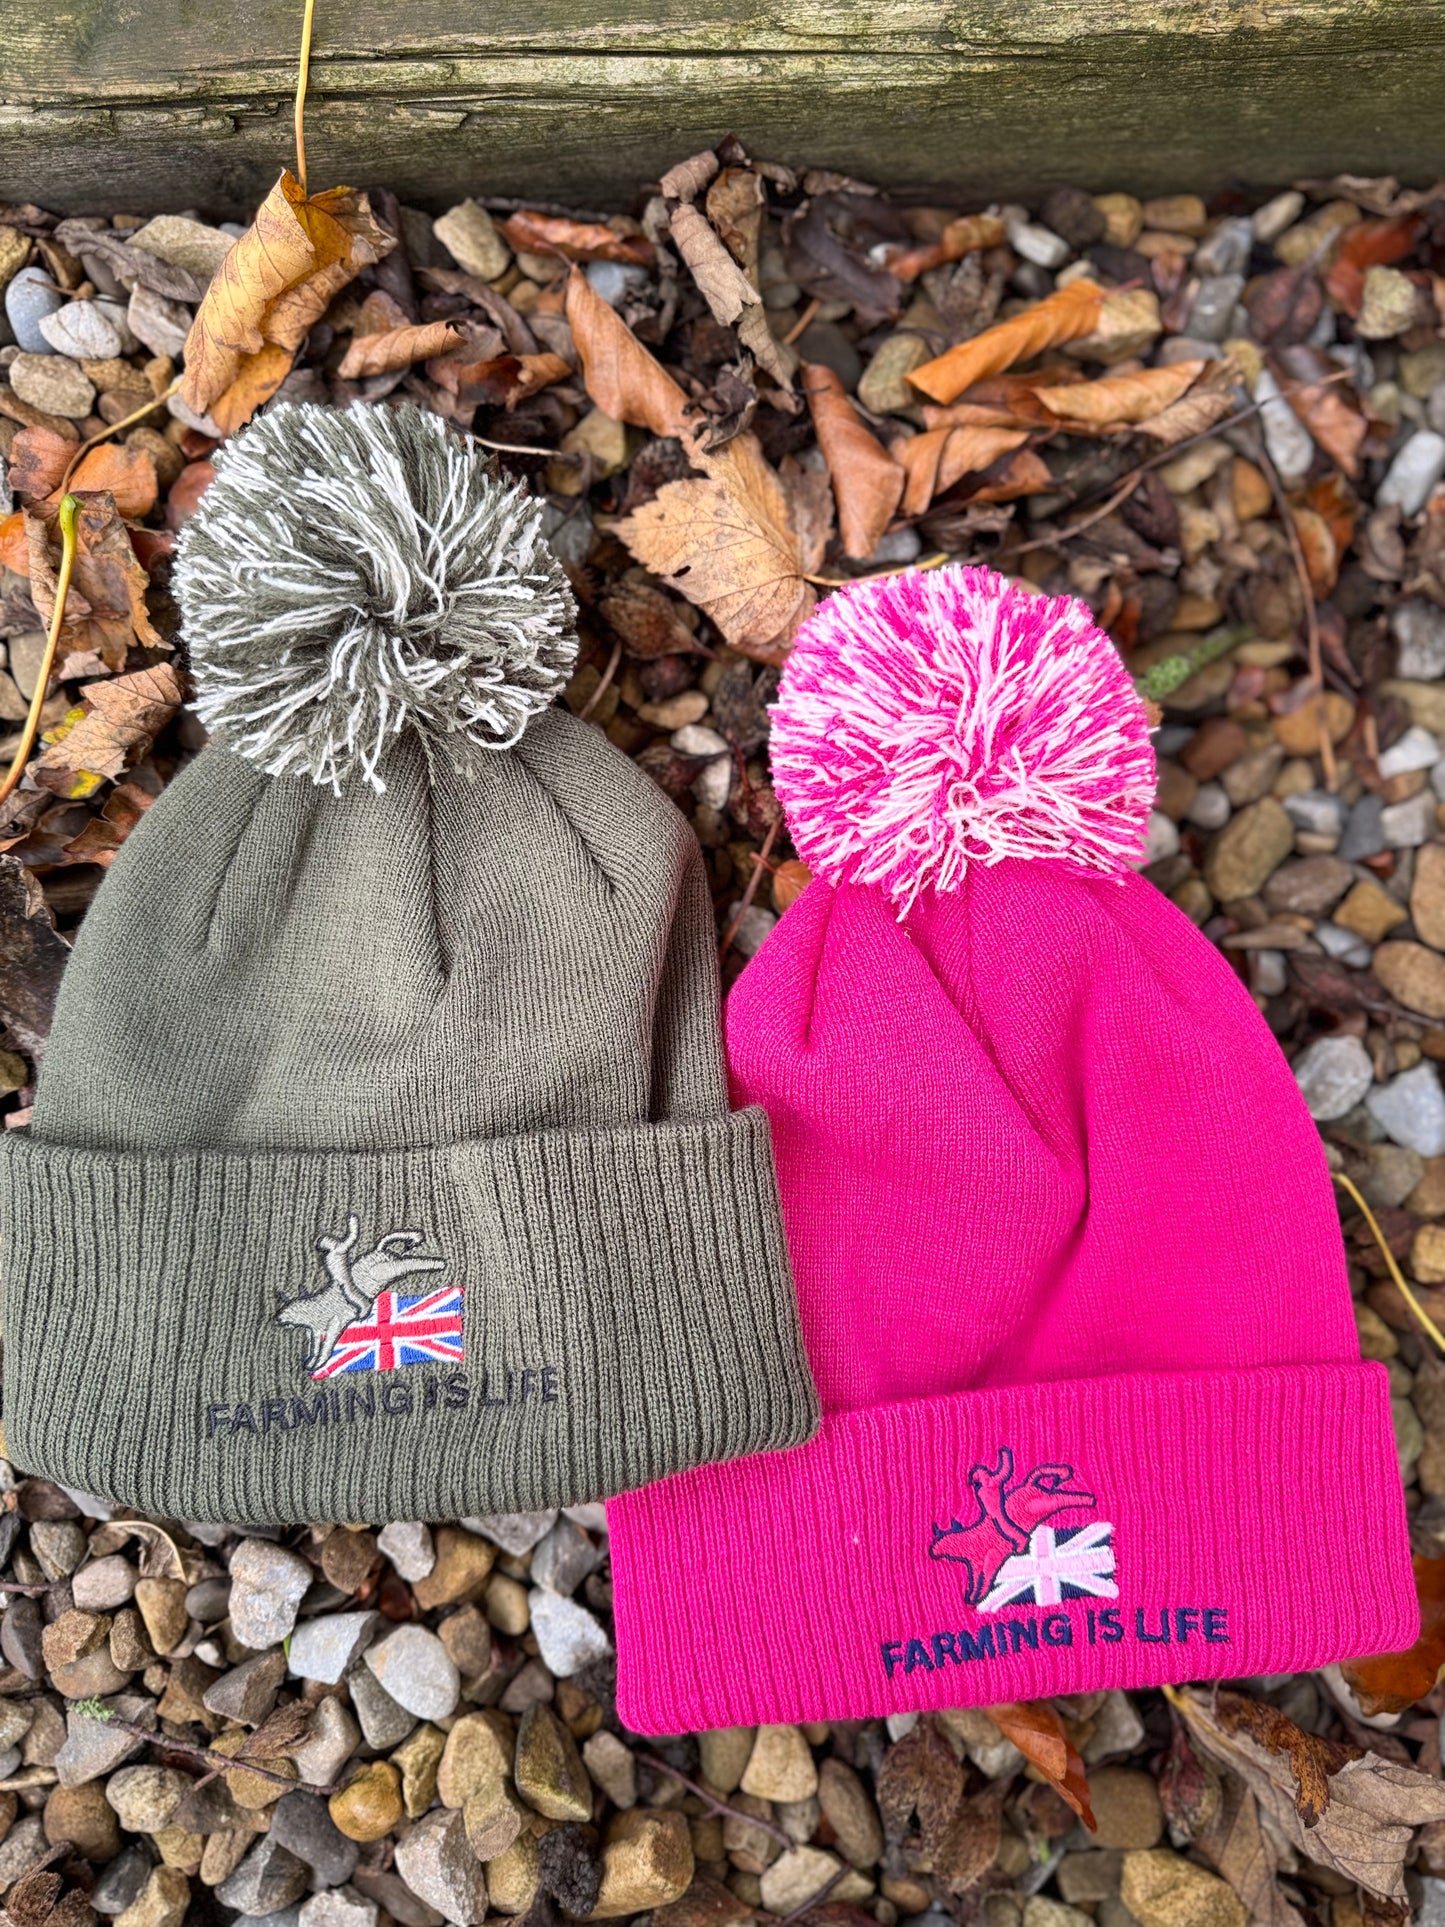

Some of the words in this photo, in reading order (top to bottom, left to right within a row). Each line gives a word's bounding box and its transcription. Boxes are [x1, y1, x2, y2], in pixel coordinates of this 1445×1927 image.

[207, 1382, 413, 1437] FARMING
[429, 1372, 469, 1410] IS
[481, 1366, 558, 1406] LIFE
[880, 1614, 1073, 1679] FARMING
[1087, 1609, 1123, 1645] IS
[1136, 1607, 1230, 1644] LIFE
